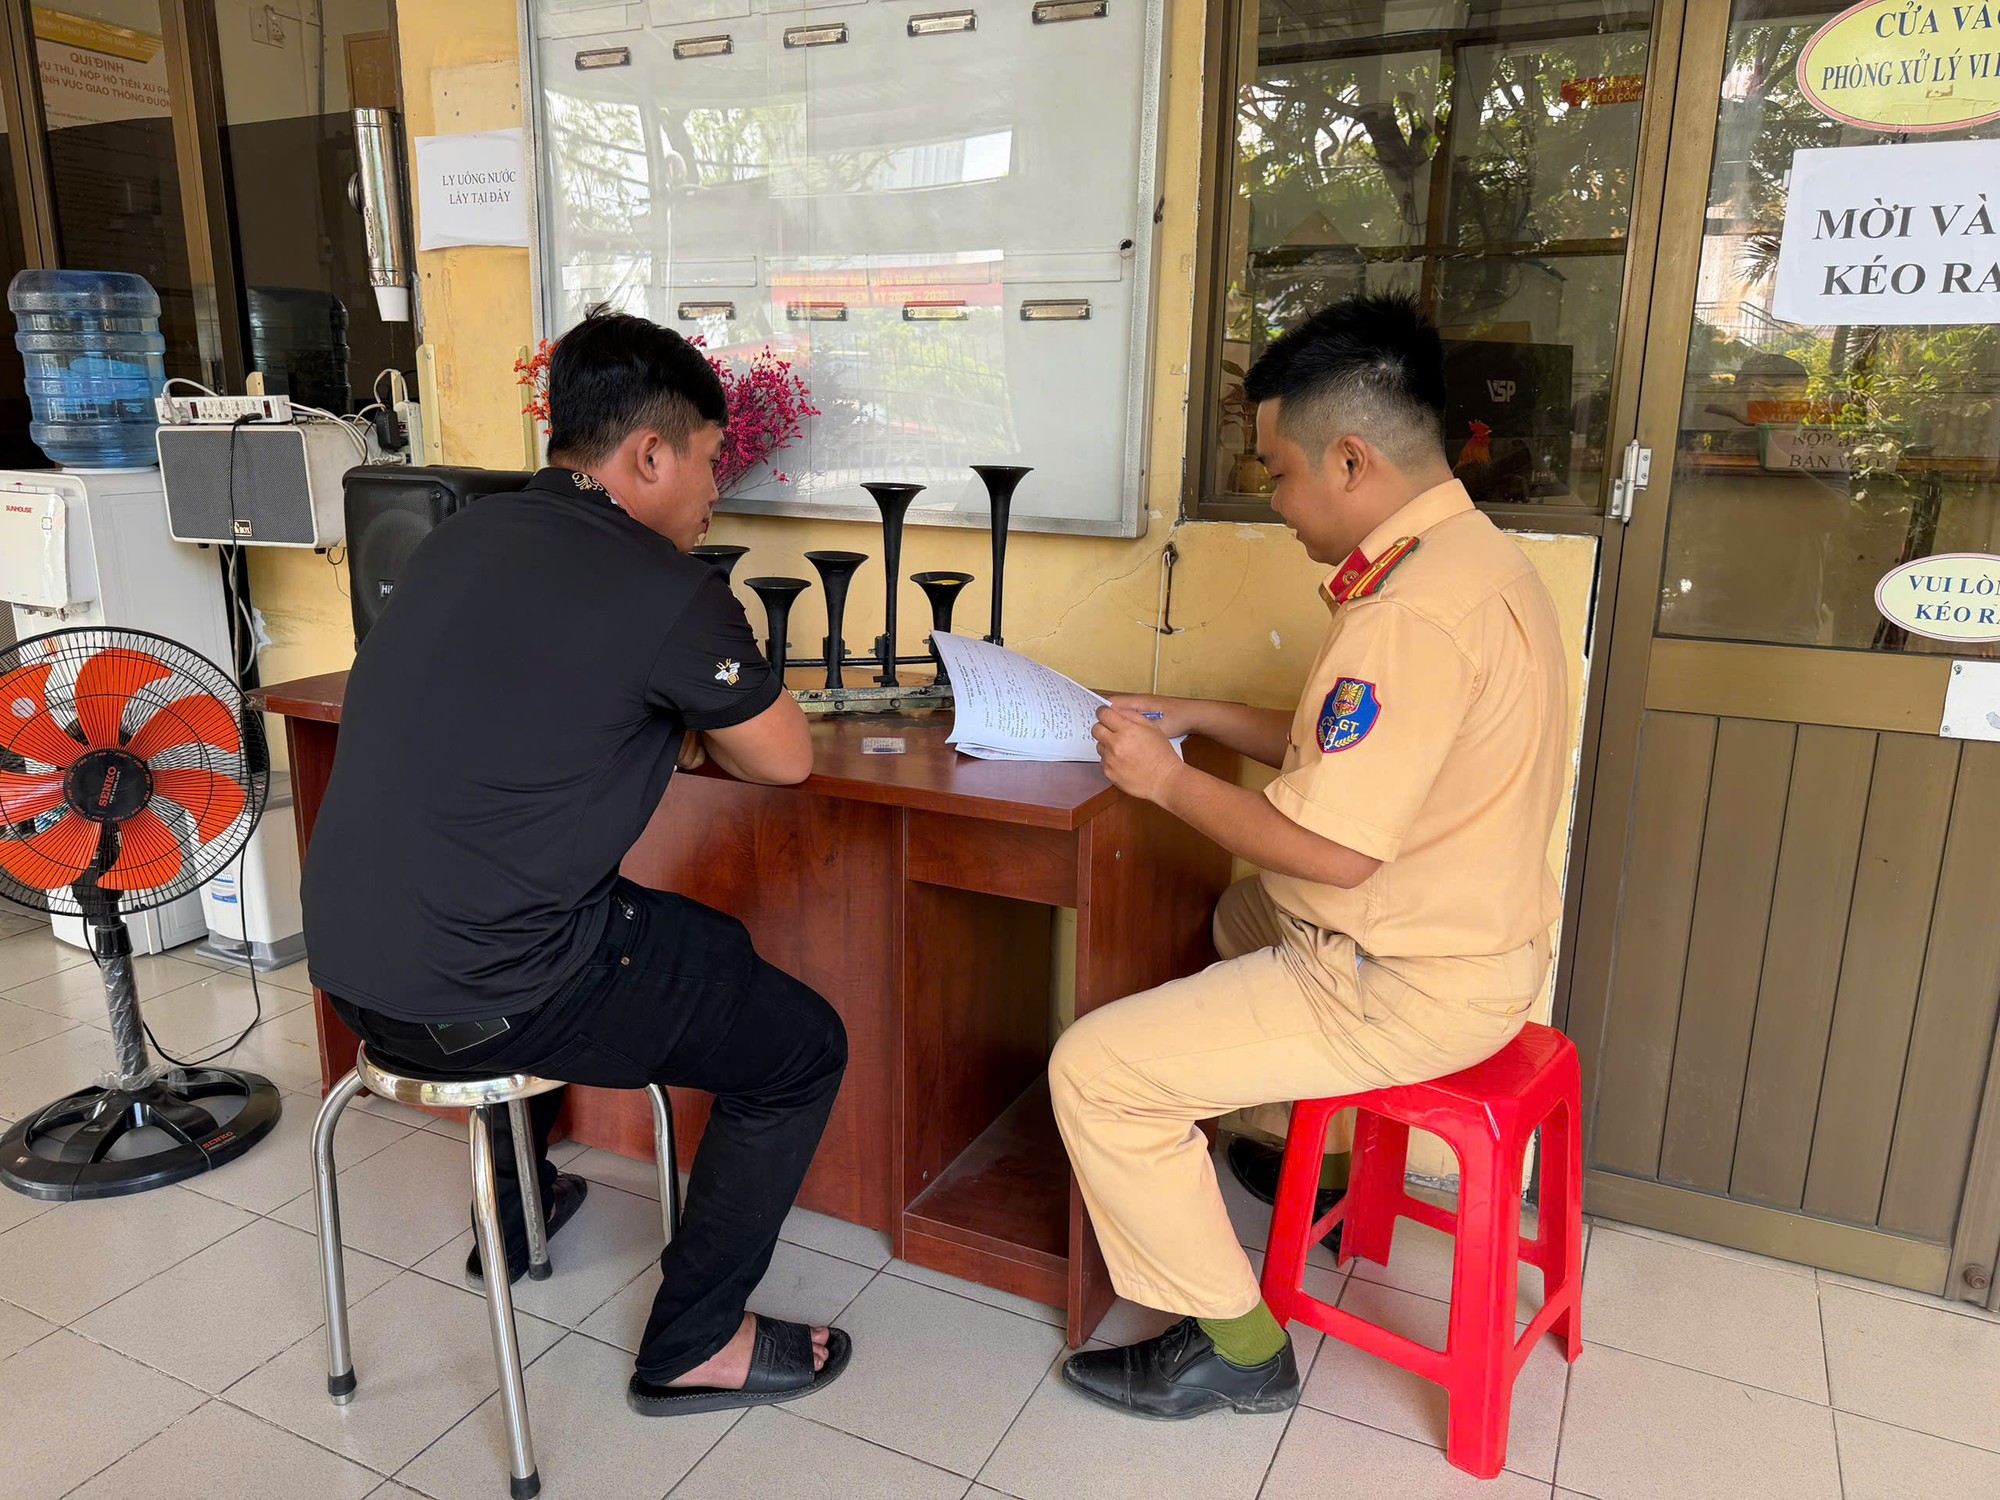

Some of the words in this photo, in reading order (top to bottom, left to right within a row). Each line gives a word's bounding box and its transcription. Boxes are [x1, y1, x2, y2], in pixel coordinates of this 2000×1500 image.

[1875, 1, 1938, 38] CỬA
[1821, 57, 1893, 91] PHÒNG
[1897, 49, 1931, 85] XỬ
[1932, 48, 1962, 82] LÝ
[442, 174, 455, 187] LY
[487, 168, 517, 184] NƯỚC
[471, 192, 487, 206] TẠI
[490, 188, 511, 203] ĐÂY
[1812, 197, 1917, 241] MỜI
[1819, 255, 1926, 296] KÉO
[1938, 261, 2000, 294] RA
[1909, 575, 1953, 594] VUI
[1915, 601, 1971, 622] KÉO
[98, 766, 117, 807] SENKO
[203, 1131, 234, 1149] SENKO
